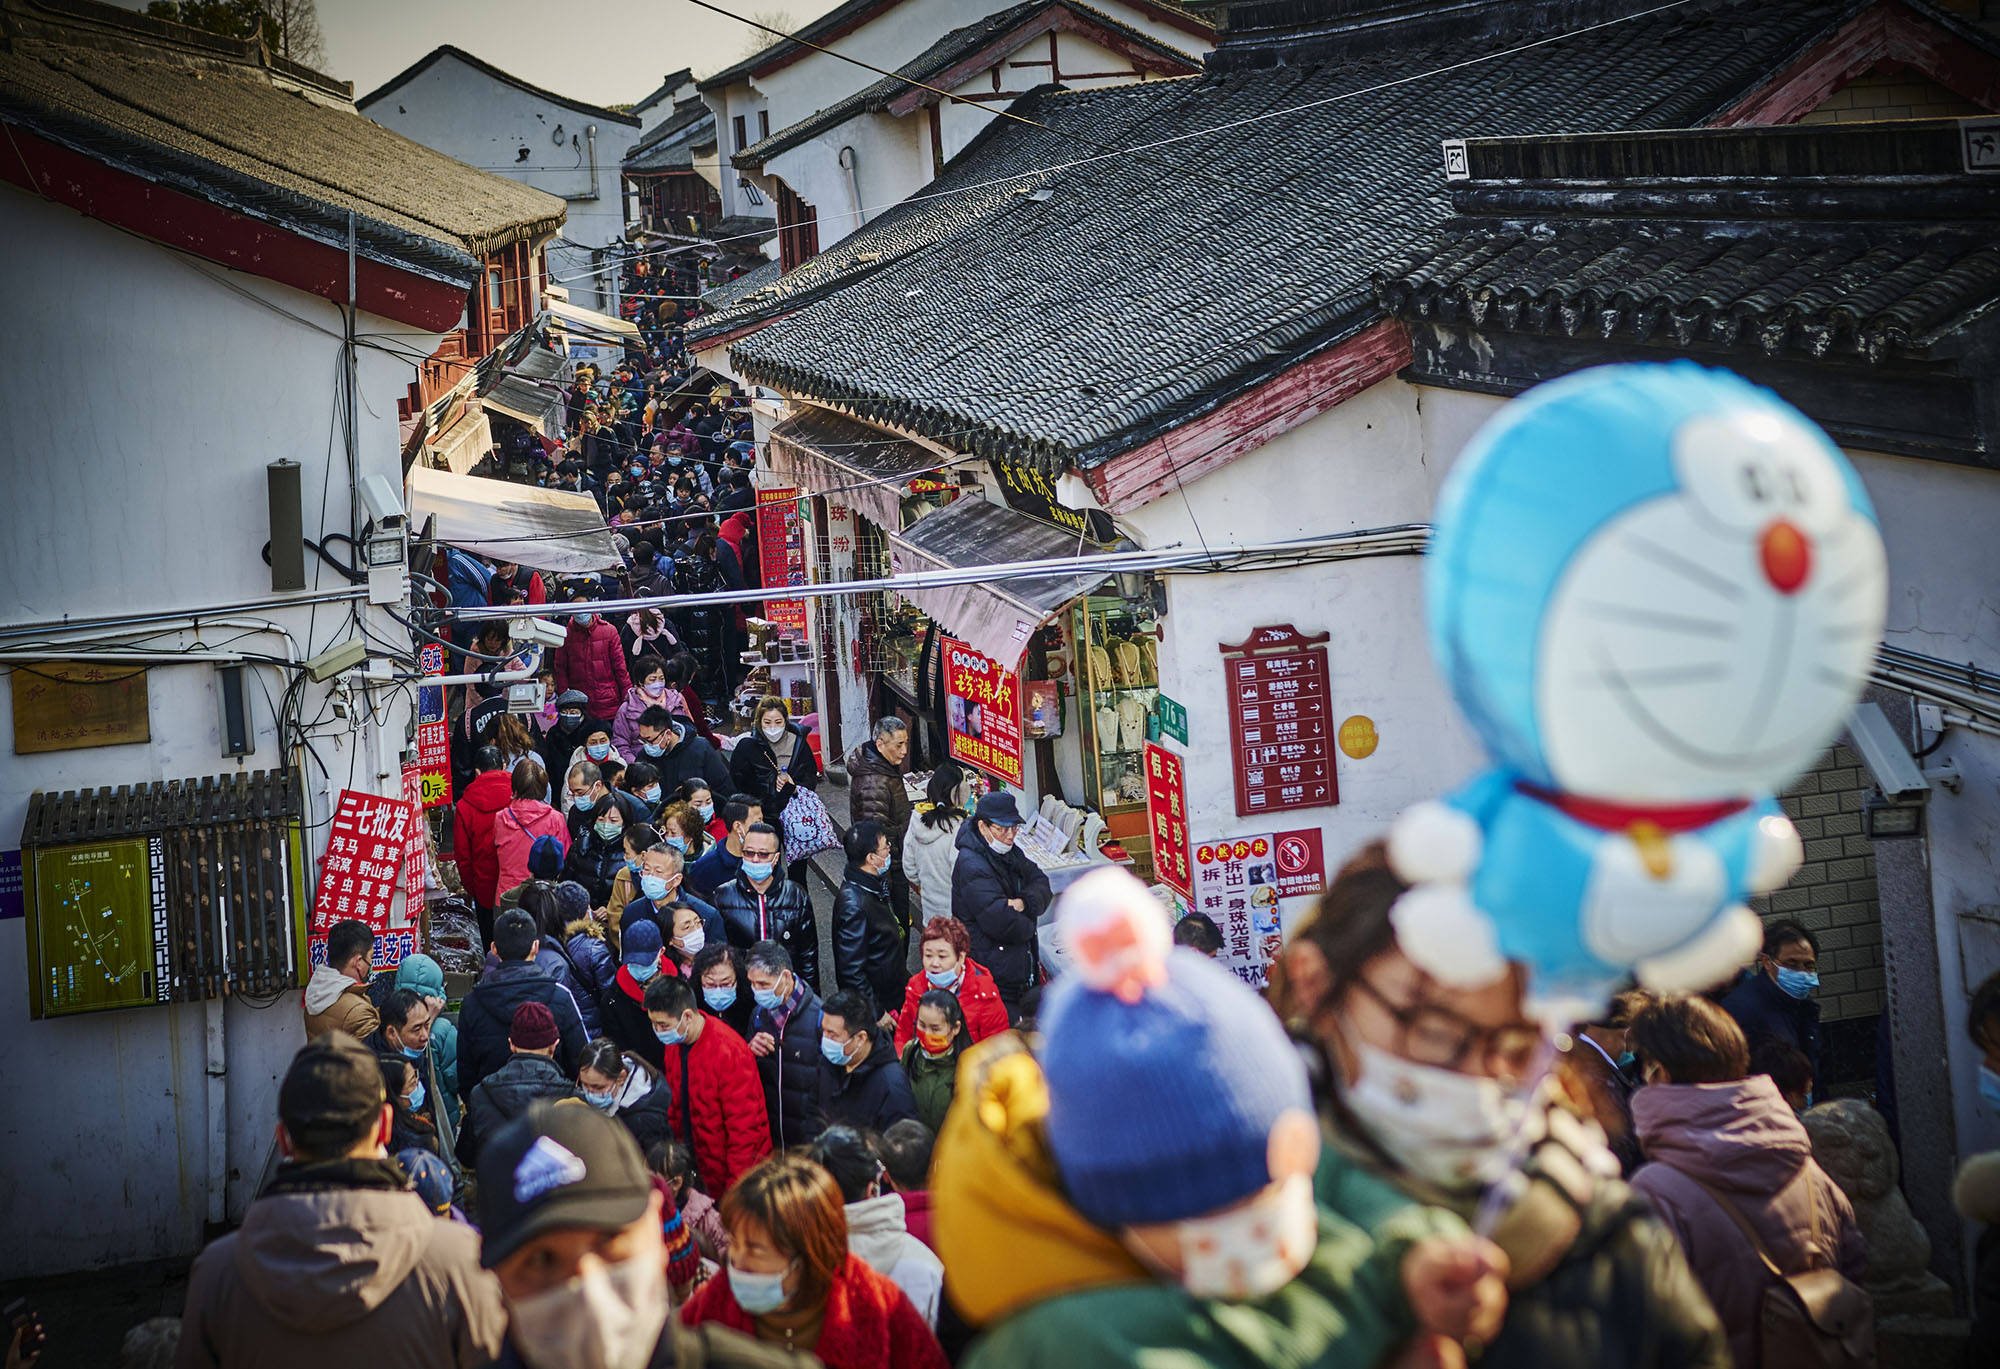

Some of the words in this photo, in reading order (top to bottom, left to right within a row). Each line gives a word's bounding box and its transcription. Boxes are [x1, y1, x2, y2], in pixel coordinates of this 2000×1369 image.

[1164, 700, 1177, 725] 76
[419, 724, 445, 746] 斤黑芝麻
[335, 796, 410, 844] 三七批发
[1151, 751, 1171, 869] 假一赔十
[1167, 759, 1186, 880] 天然珍珠
[332, 835, 359, 855] 海马
[371, 843, 400, 863] 鹿茸
[1199, 840, 1267, 861] 天然珍珠
[327, 854, 353, 873] 燕窝
[358, 860, 396, 881] 野山参
[1278, 872, 1320, 887] 勿随地吐痰
[323, 873, 391, 900] 冬虫夏草
[1286, 883, 1321, 894] SPITTING
[318, 892, 386, 919] 大连海参
[1223, 860, 1252, 961] 拆出一身珠光宝气
[314, 911, 382, 931] 灵芝油
[372, 930, 414, 966] 黑芝麻
